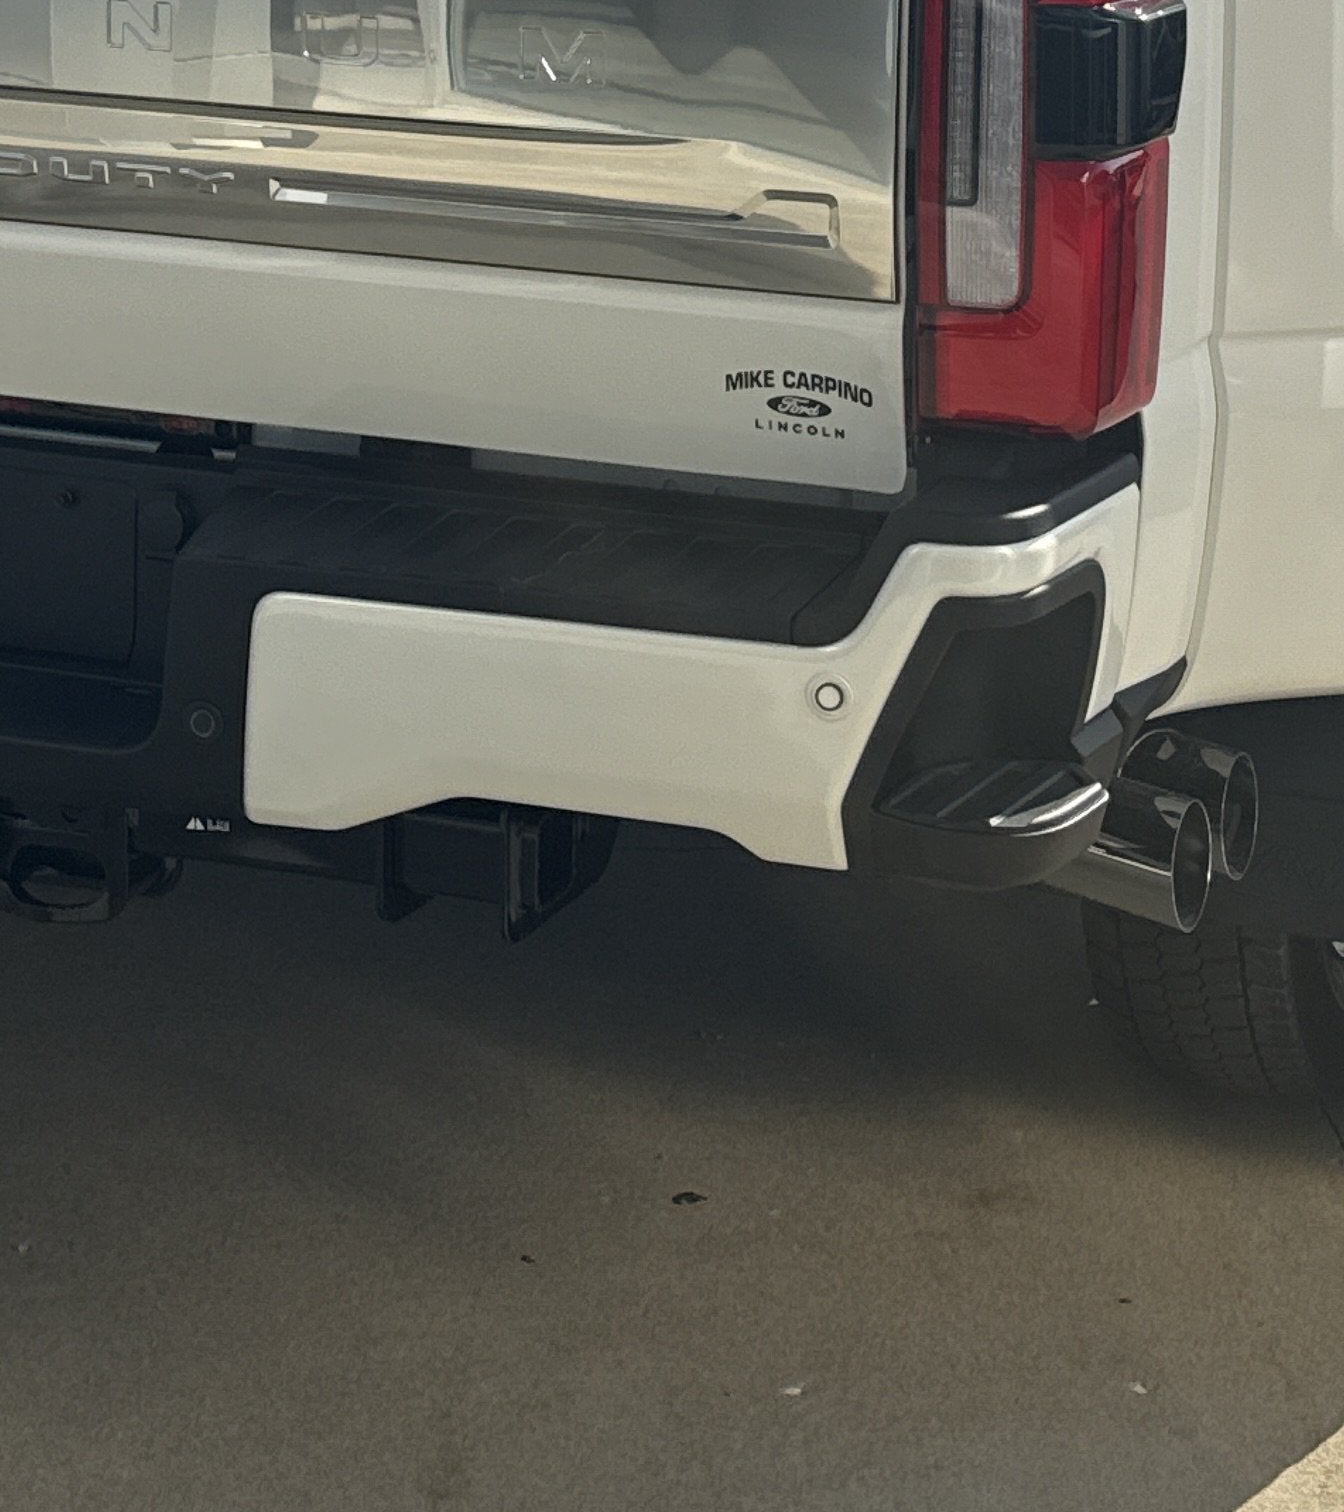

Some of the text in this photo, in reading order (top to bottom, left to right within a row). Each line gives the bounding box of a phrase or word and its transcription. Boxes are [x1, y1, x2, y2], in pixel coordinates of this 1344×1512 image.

[724, 370, 874, 408] MIKE CARPINO
[776, 396, 821, 417] Ford
[755, 418, 846, 439] LINCOLN
